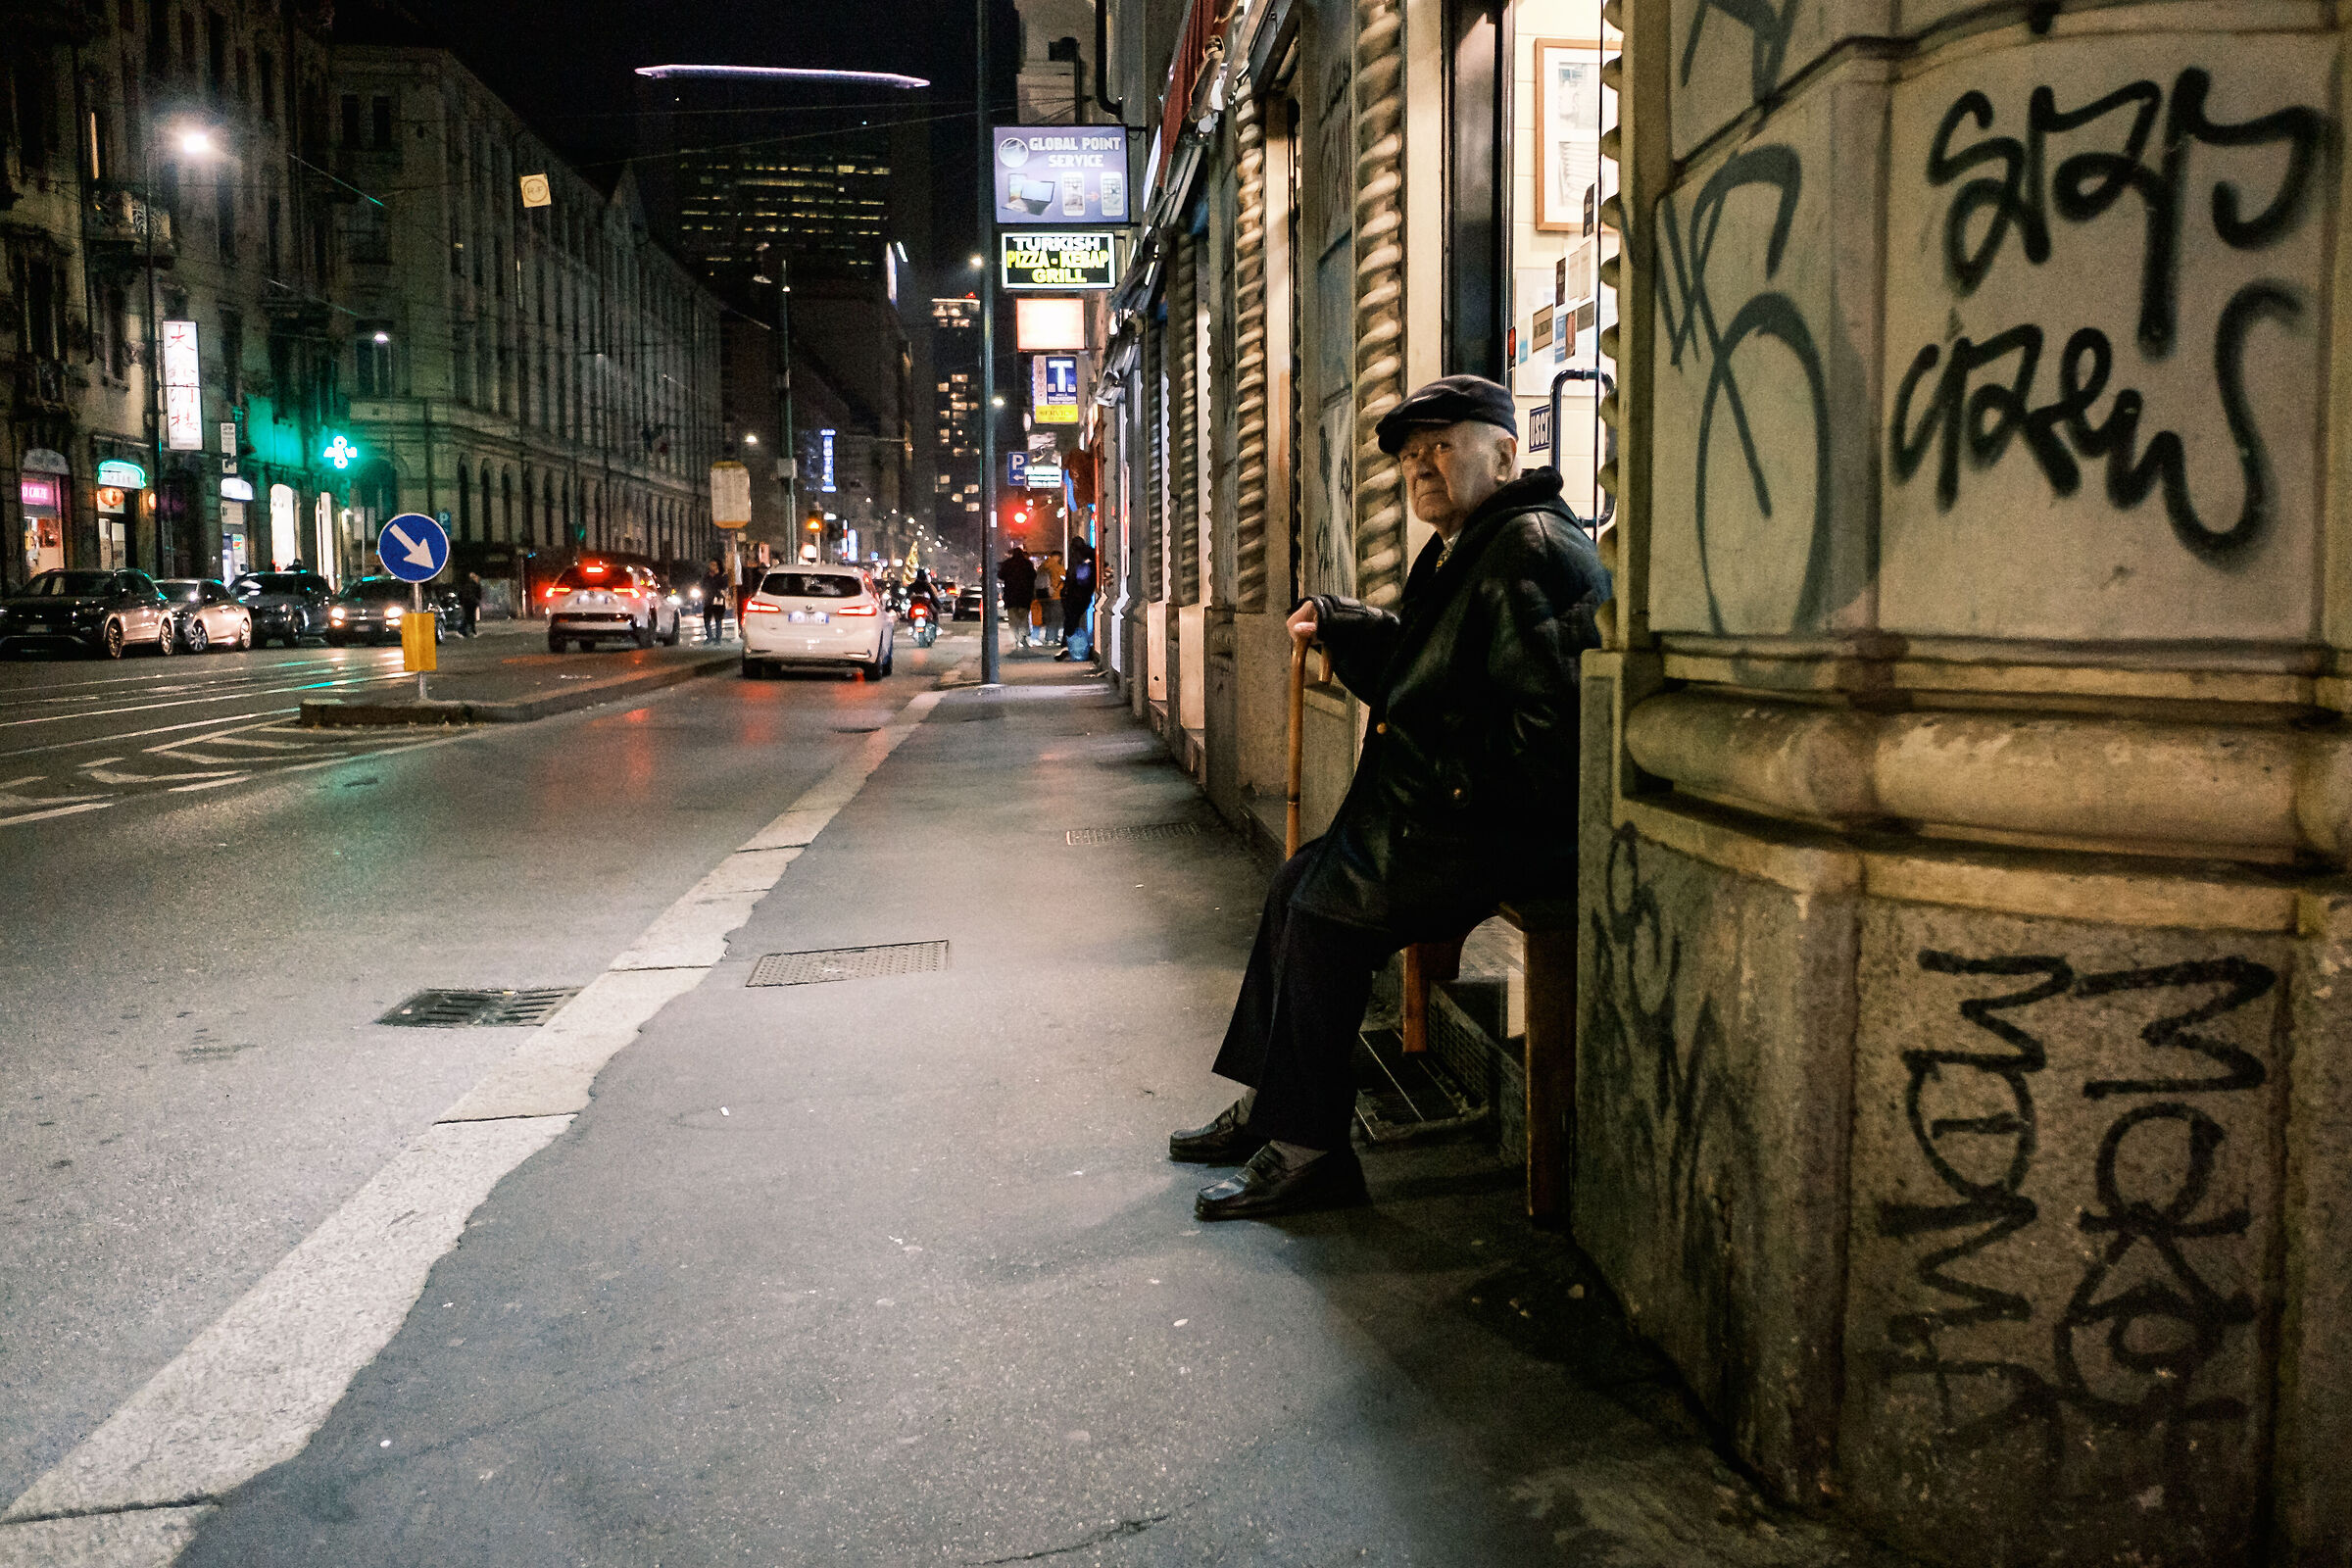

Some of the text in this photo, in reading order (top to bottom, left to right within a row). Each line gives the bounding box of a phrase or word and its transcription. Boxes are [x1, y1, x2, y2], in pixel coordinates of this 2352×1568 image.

[1029, 137, 1121, 151] GLOBAL POINT
[1048, 154, 1104, 168] SERVICE
[1012, 237, 1101, 252] TURKISH
[1006, 250, 1109, 269] PIZZA KEBAP
[1032, 268, 1088, 283] GRILL
[1048, 360, 1074, 393] T
[1530, 410, 1551, 447] USCI
[1012, 454, 1024, 470] P
